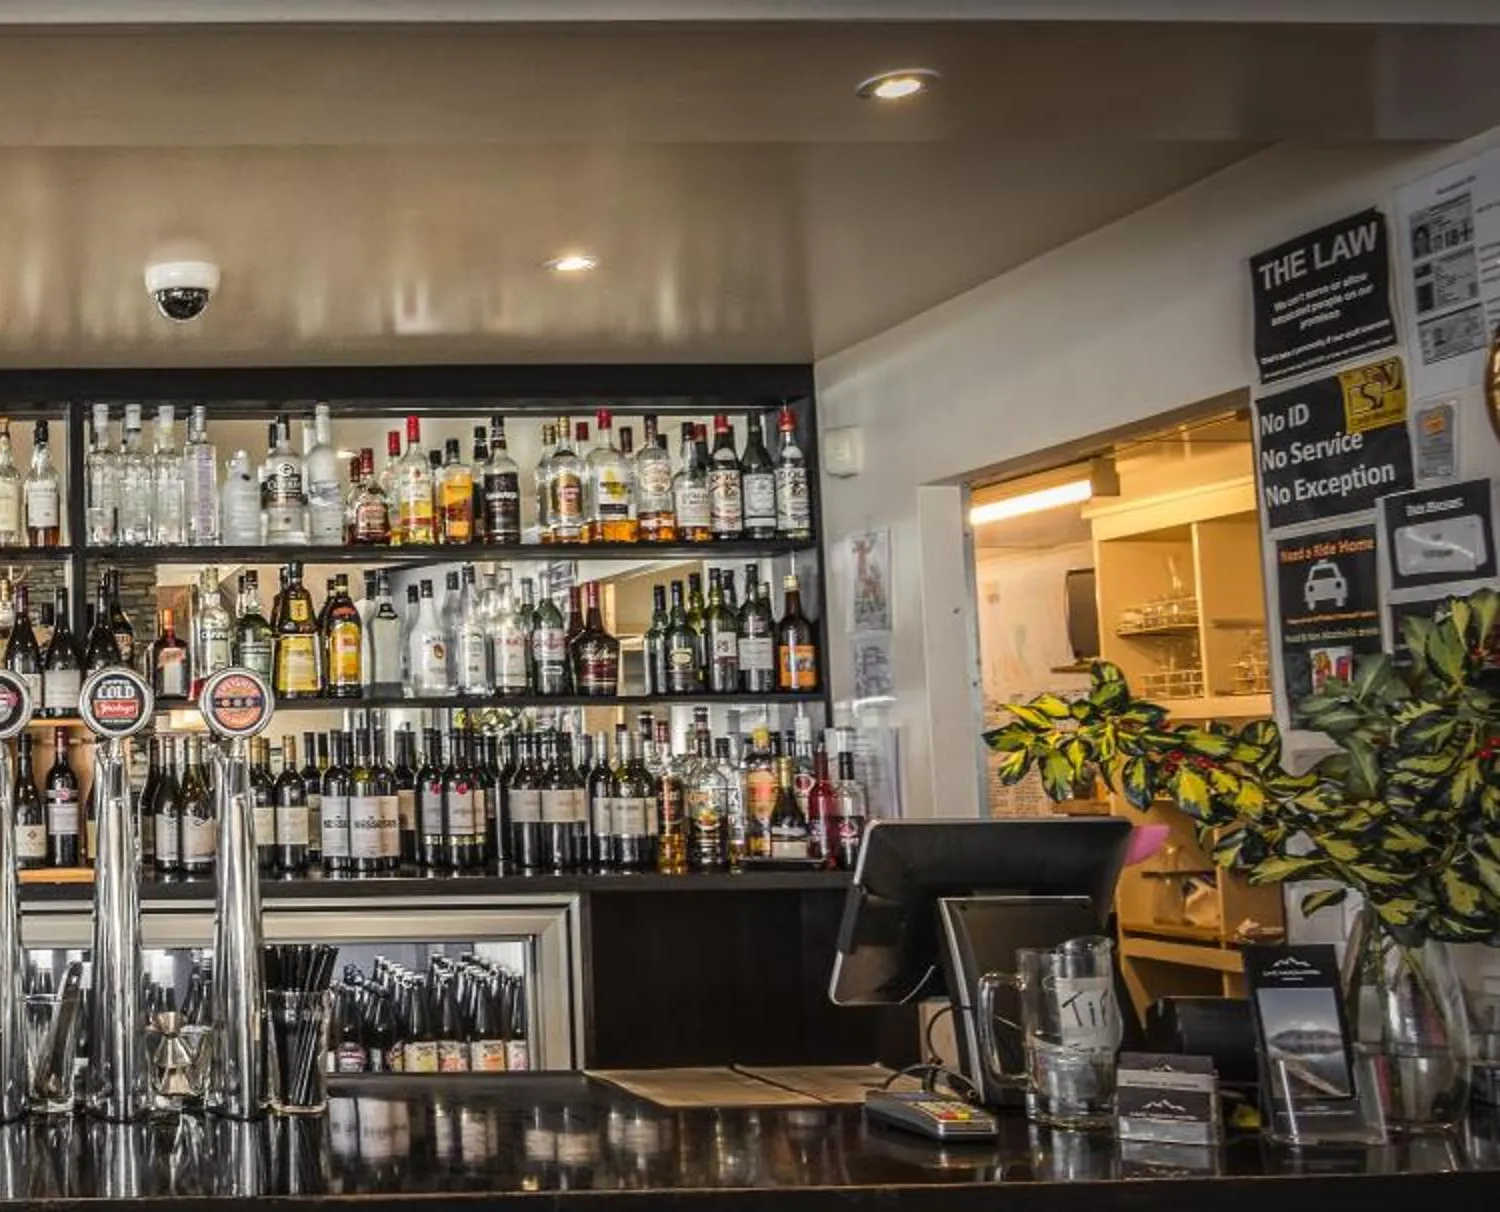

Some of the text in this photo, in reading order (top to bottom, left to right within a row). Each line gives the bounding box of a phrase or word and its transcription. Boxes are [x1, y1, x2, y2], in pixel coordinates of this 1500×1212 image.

[1259, 222, 1378, 289] THE LAW
[1261, 403, 1310, 436] No ID
[1262, 431, 1364, 472] No Service
[1265, 463, 1396, 508] No Exception
[98, 686, 135, 698] COLD
